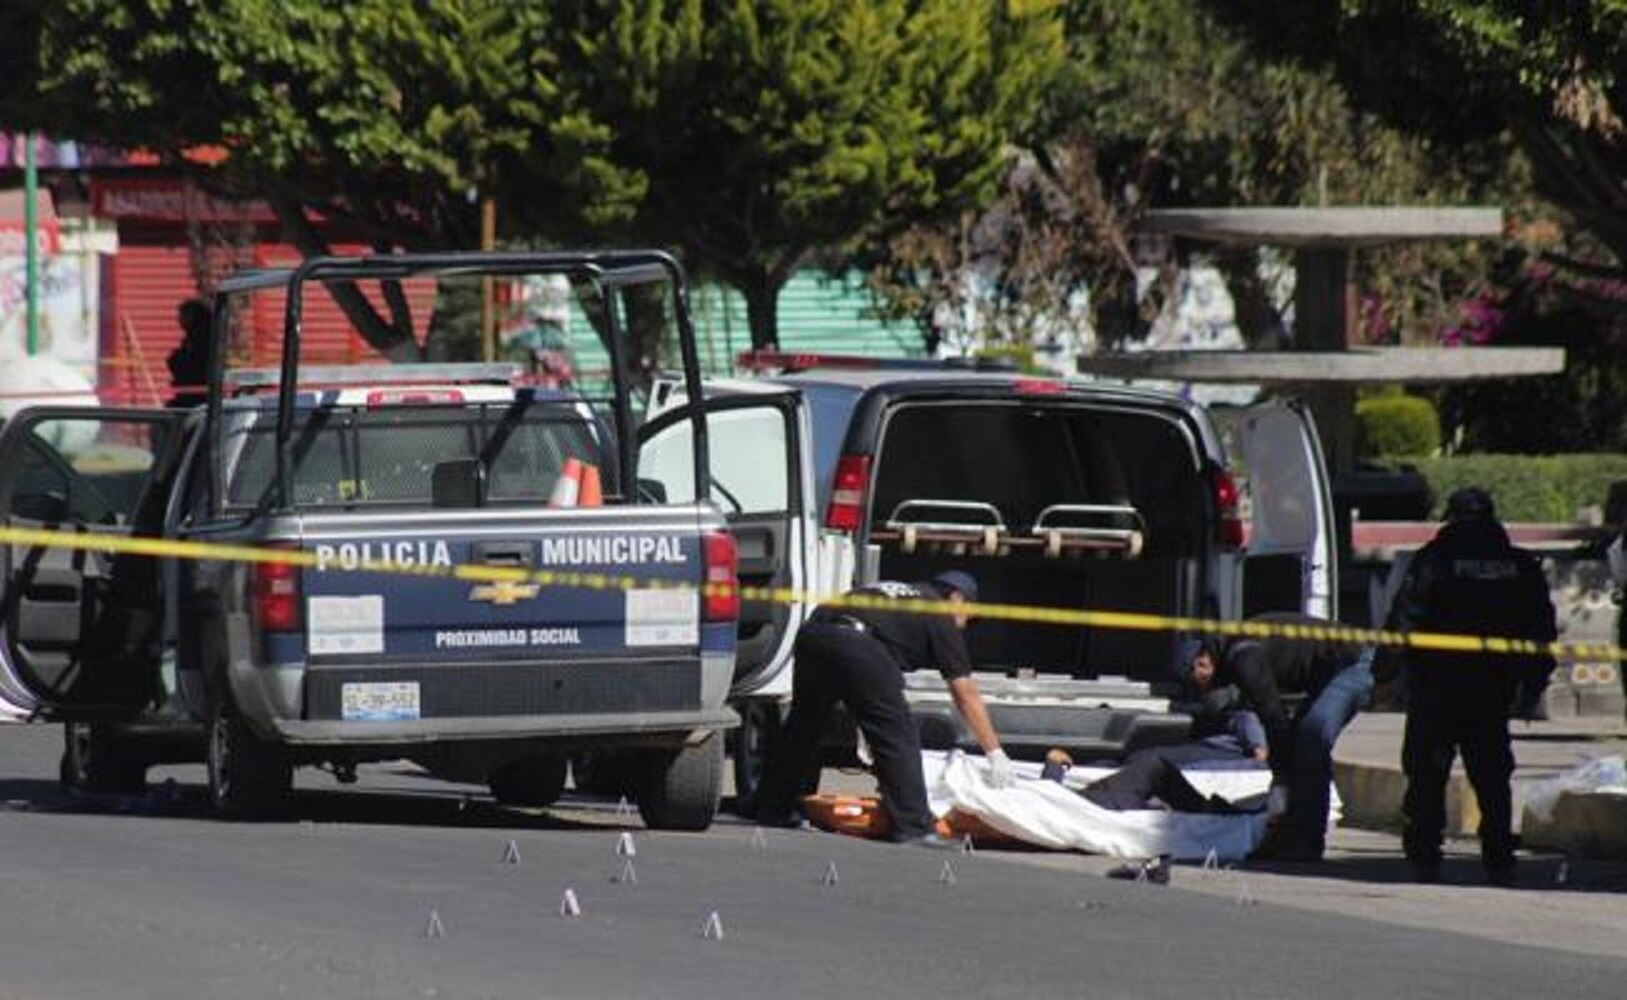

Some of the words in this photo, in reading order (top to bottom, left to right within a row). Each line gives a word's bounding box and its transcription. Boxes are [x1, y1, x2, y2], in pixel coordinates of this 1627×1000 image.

[316, 540, 451, 571] POLICIA
[541, 536, 687, 564] MUNICIPAL
[436, 630, 527, 647] PROXIMIDAD
[531, 628, 581, 644] SOCIAL
